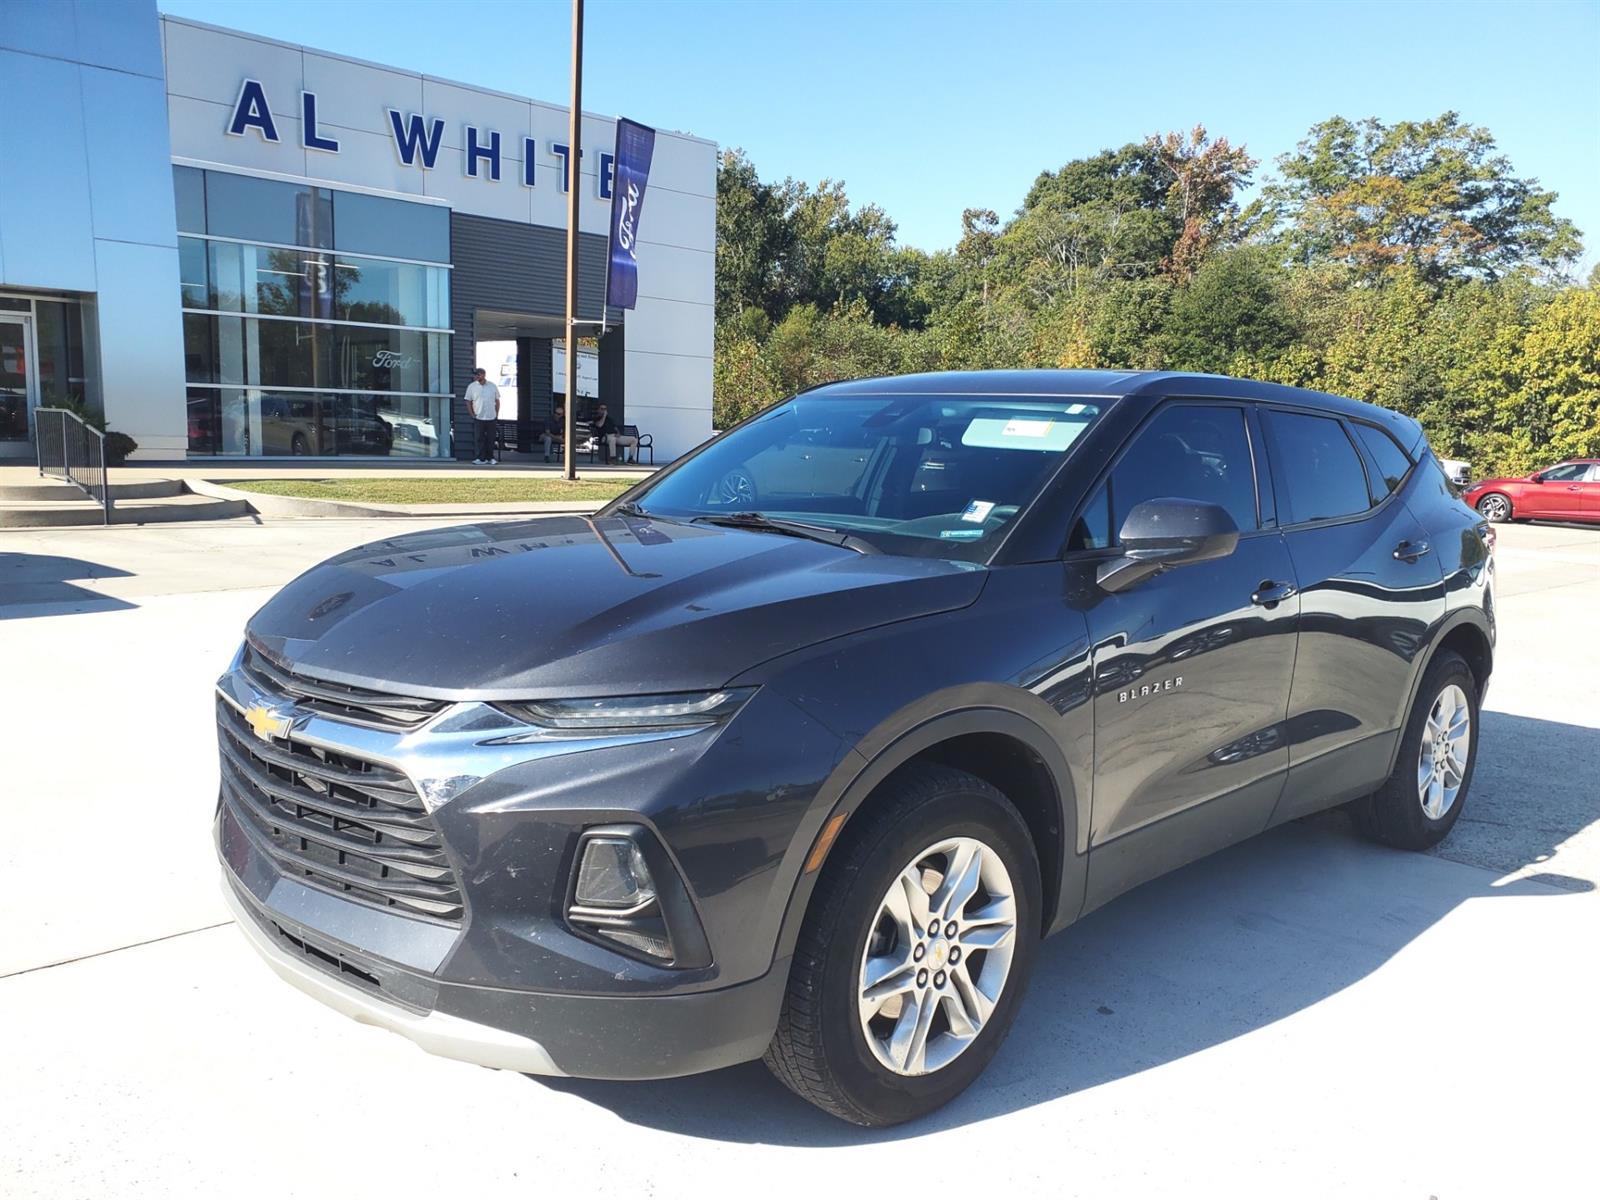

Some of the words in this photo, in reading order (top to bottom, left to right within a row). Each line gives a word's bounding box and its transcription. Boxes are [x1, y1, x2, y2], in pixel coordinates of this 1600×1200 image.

[228, 79, 341, 154] AL
[372, 350, 412, 368] Ford
[1118, 676, 1183, 703] BLAZER
